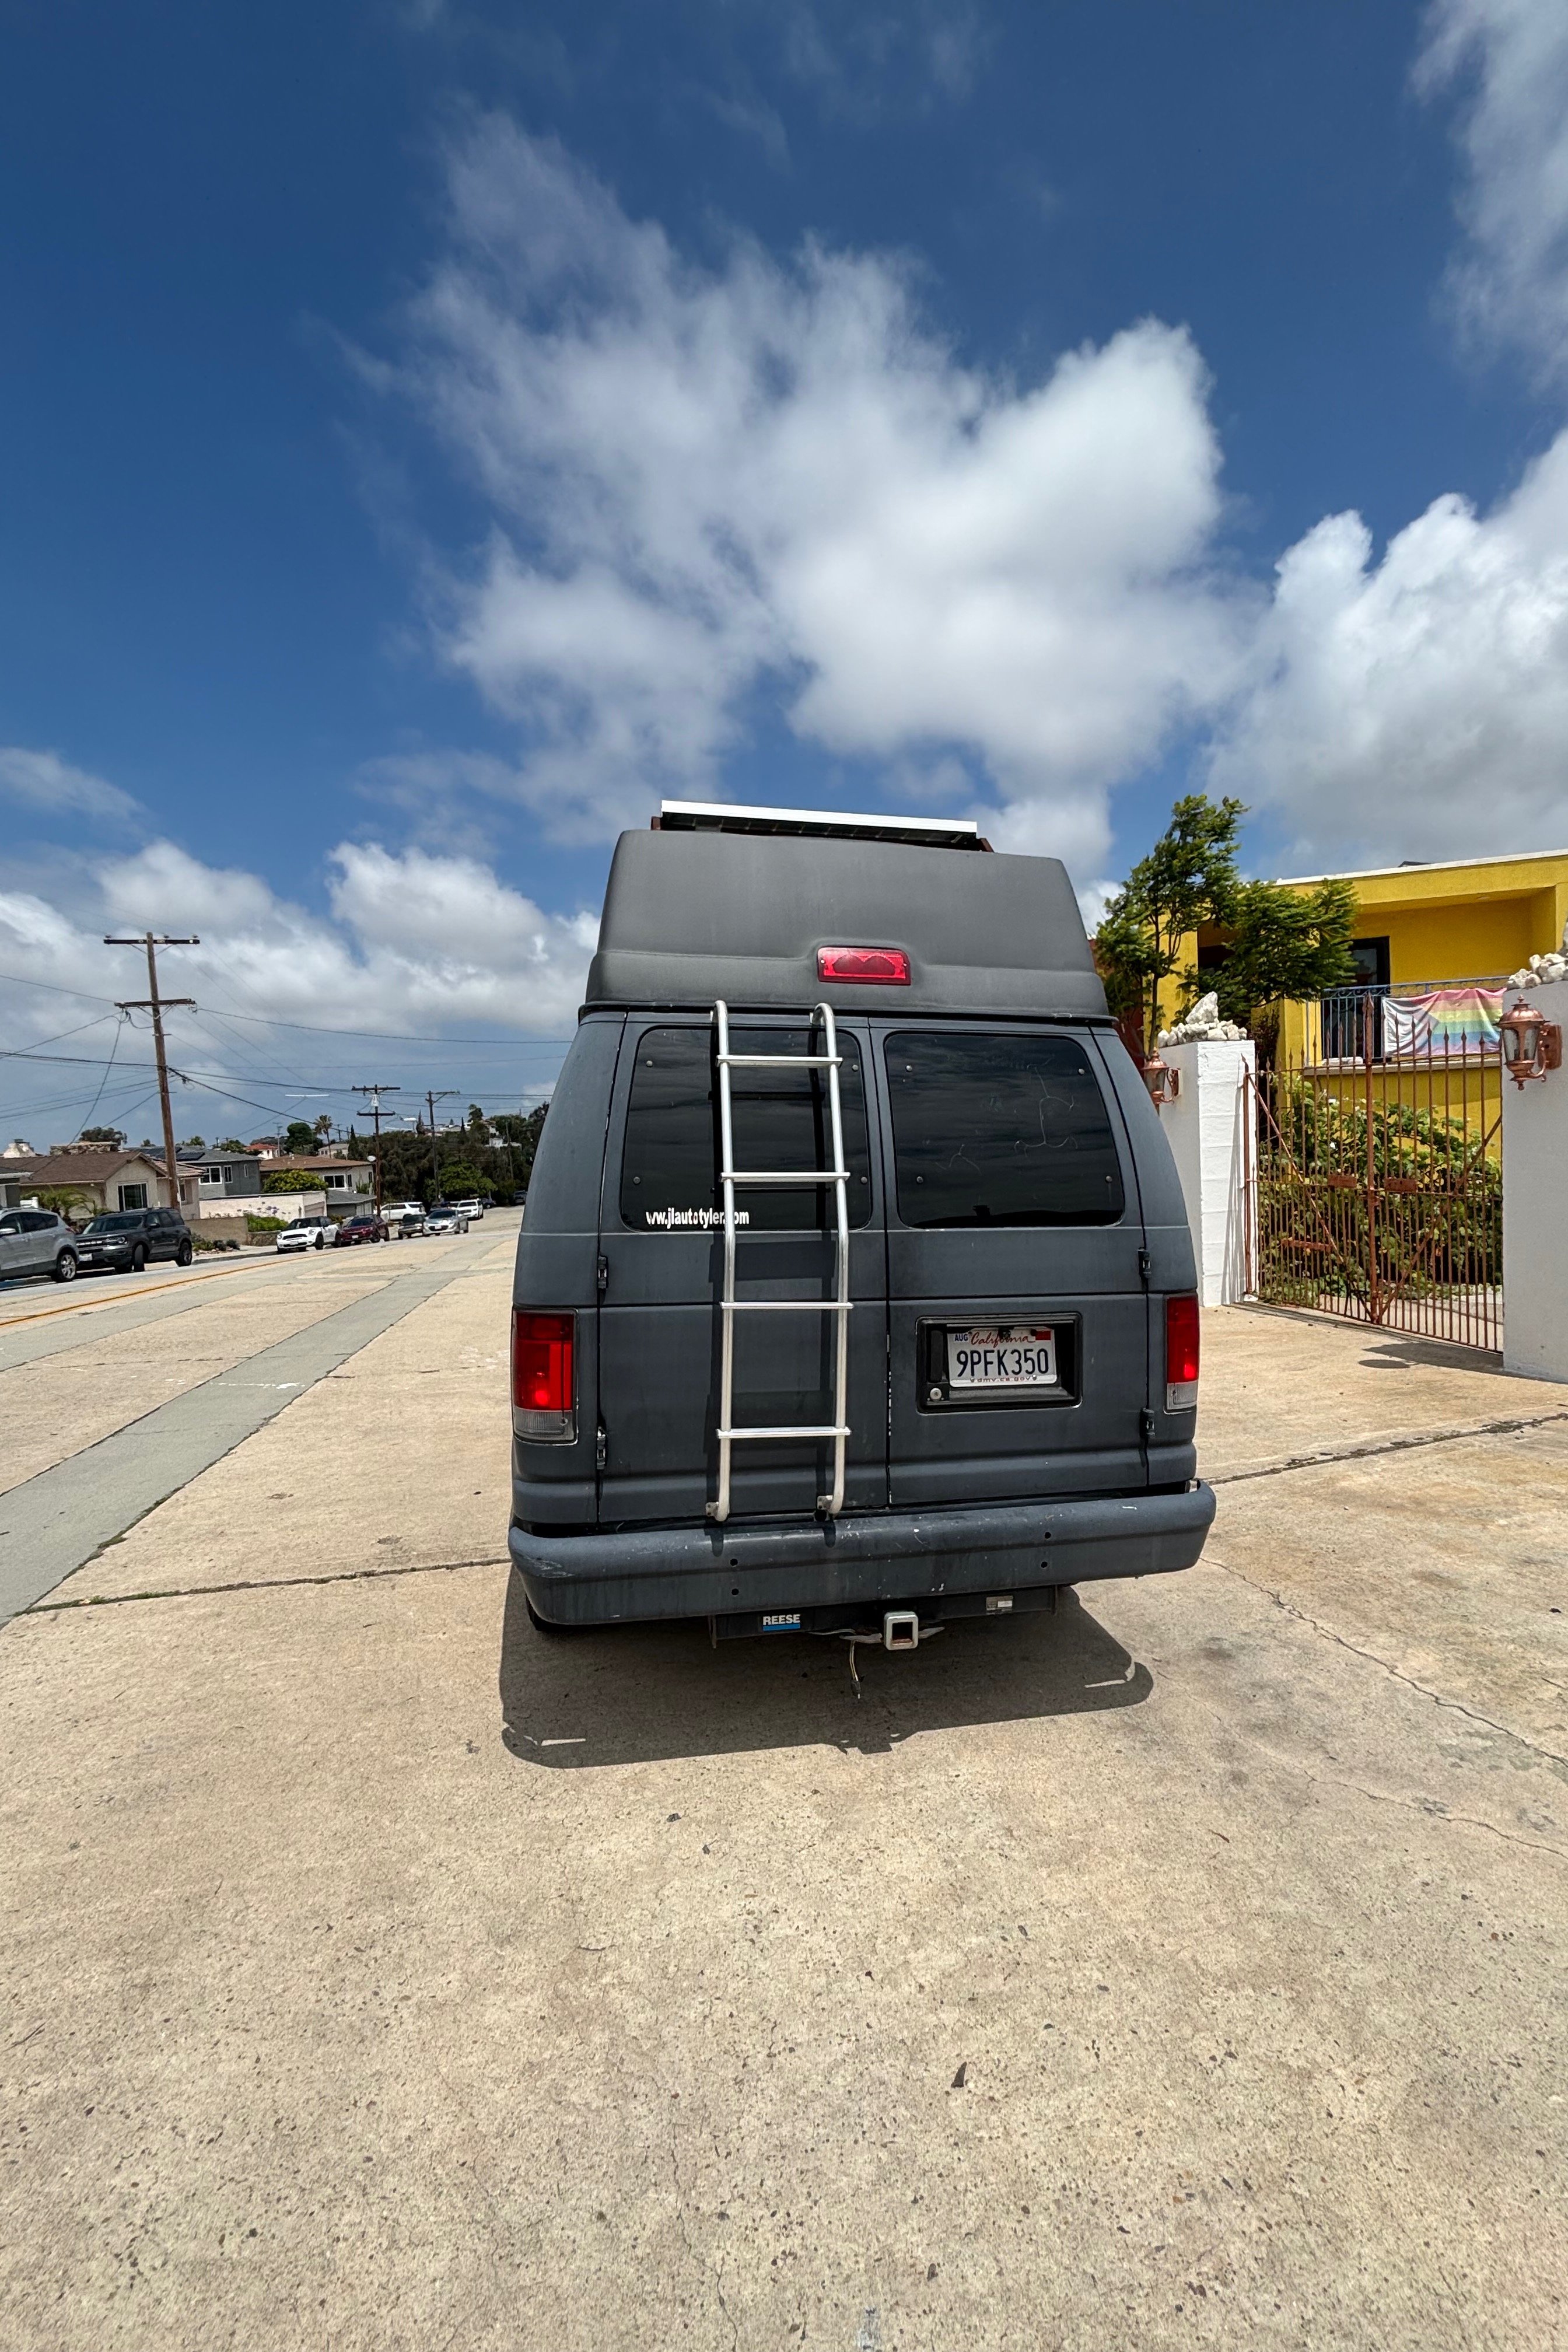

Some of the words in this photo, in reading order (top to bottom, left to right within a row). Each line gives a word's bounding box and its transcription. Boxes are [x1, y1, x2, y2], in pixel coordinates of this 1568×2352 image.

[954, 1334, 968, 1342] AUG
[971, 1331, 1035, 1348] California
[957, 1348, 1049, 1377] 9PFK350
[763, 1614, 800, 1626] REESE
